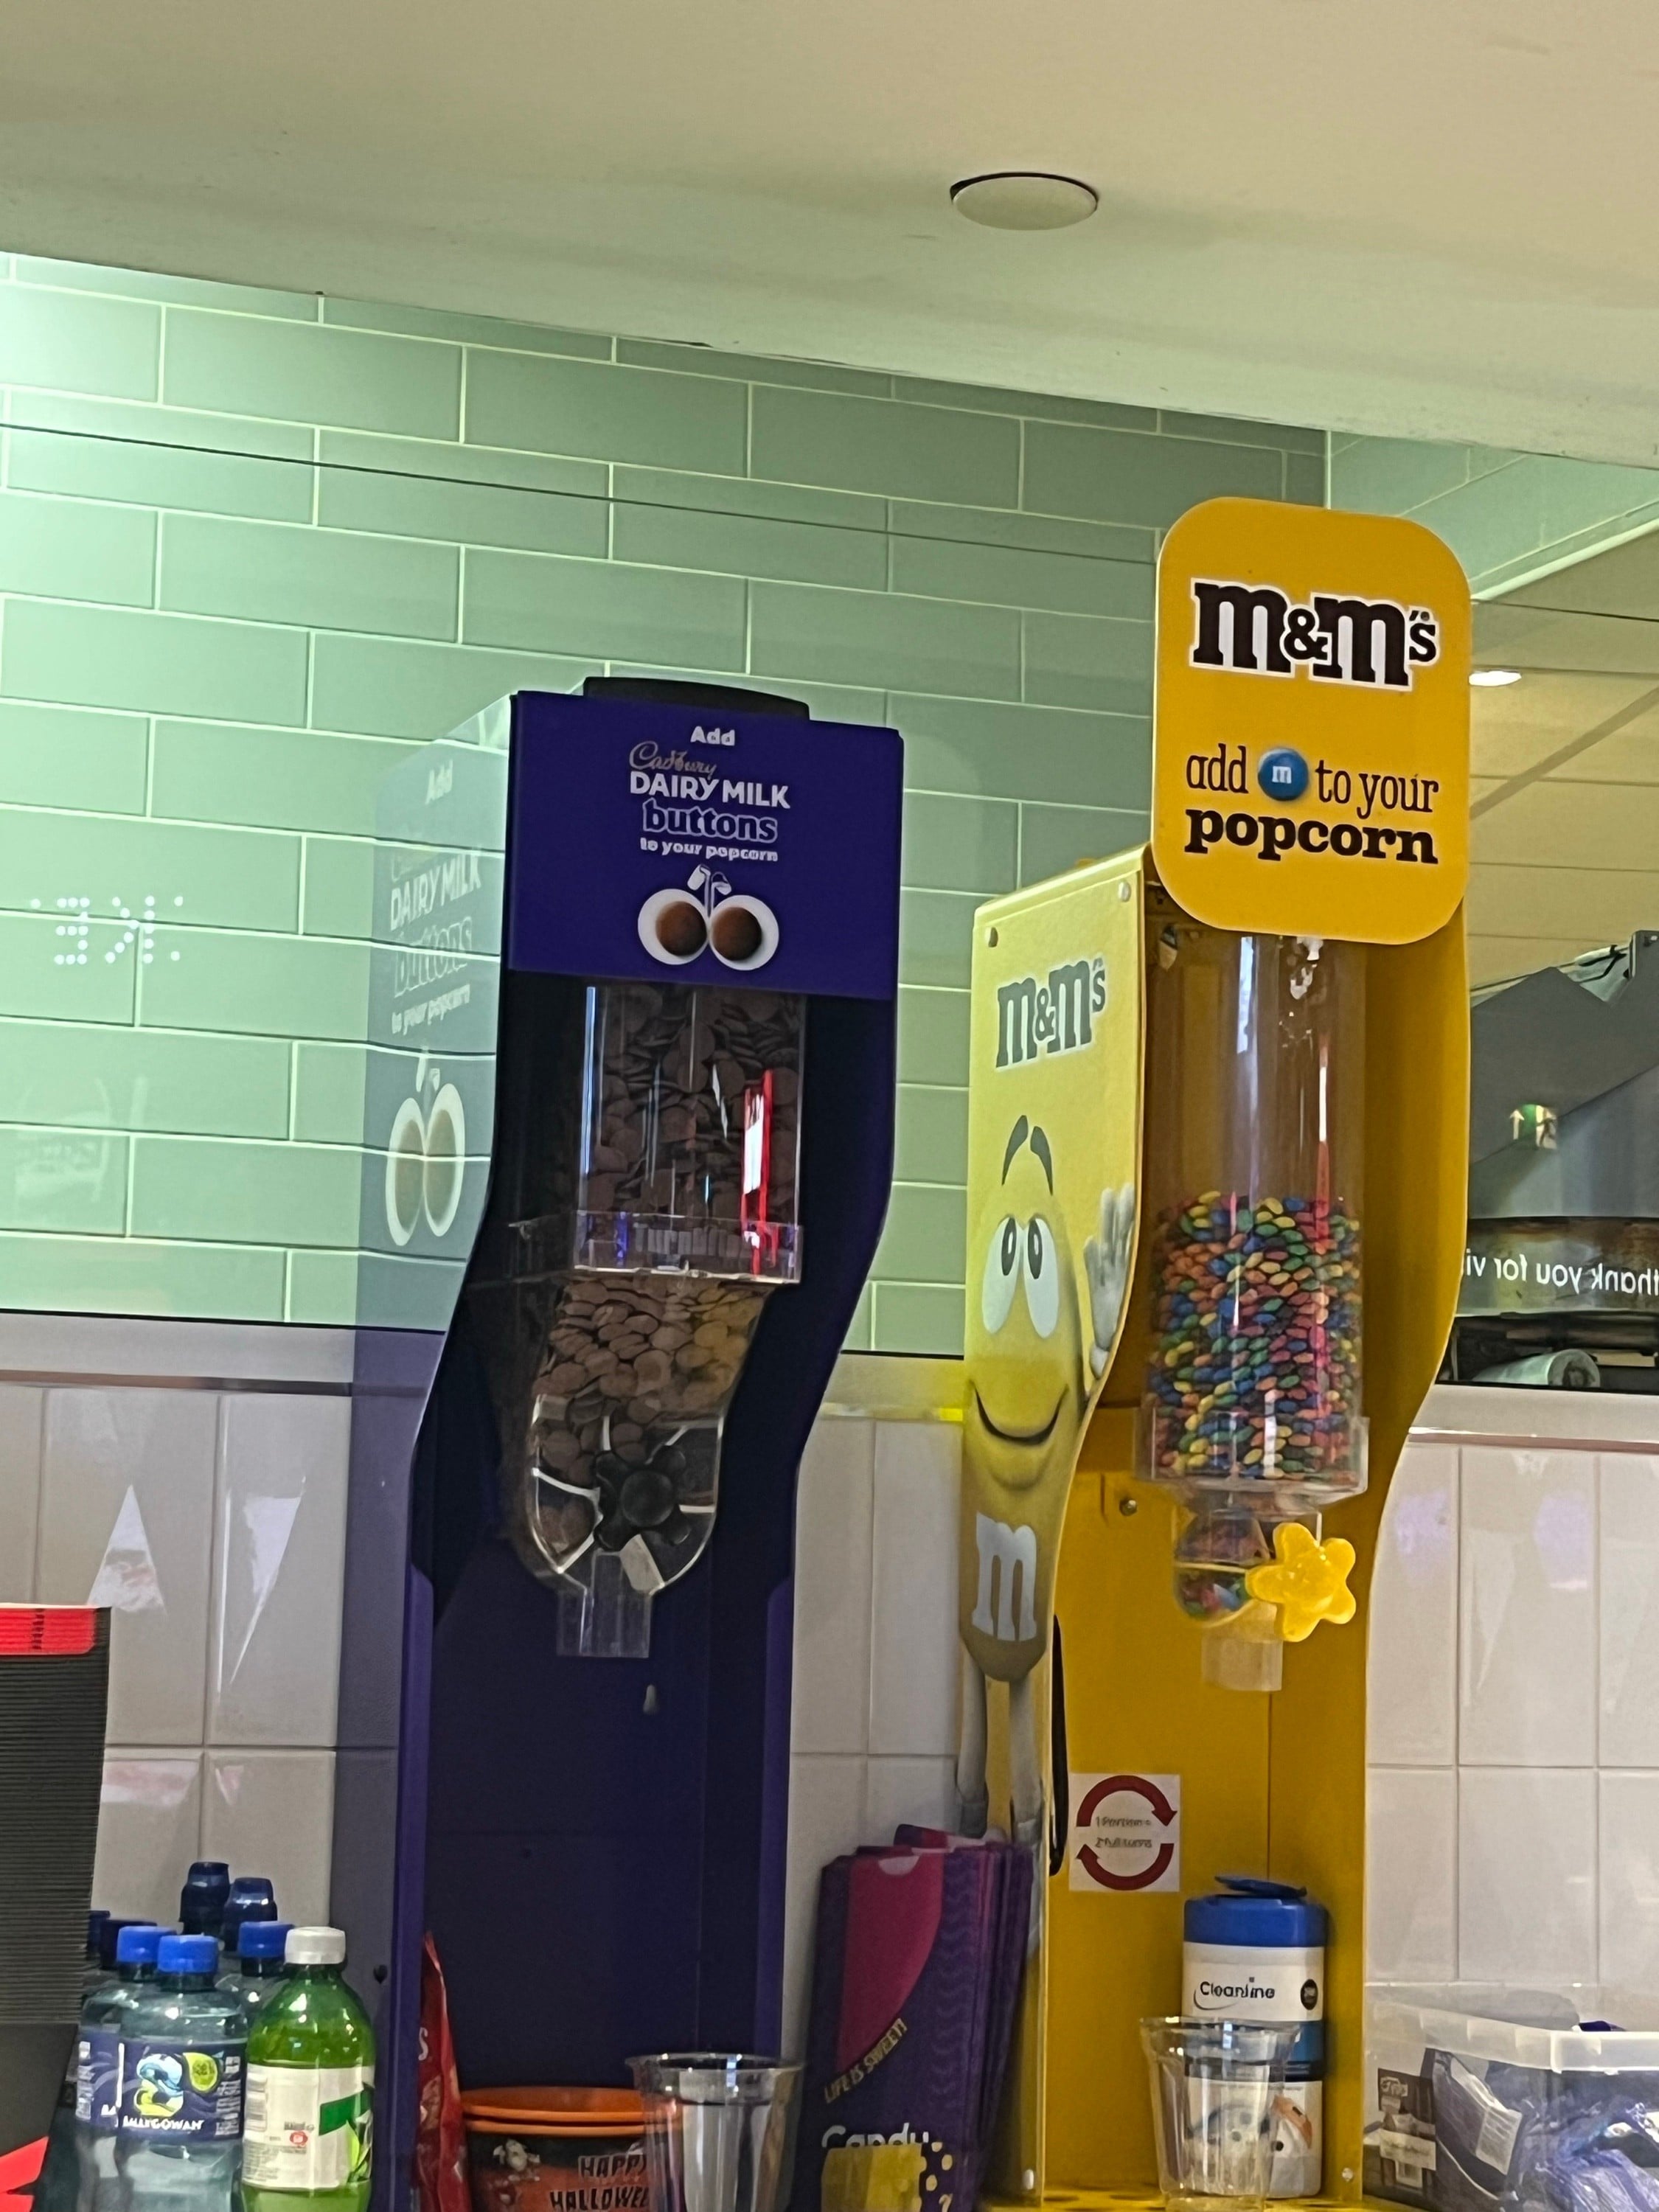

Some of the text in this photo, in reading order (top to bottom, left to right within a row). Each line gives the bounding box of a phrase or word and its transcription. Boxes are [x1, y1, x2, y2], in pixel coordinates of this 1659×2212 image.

[690, 726, 735, 746] Add
[629, 740, 717, 779] Cadbury
[630, 771, 791, 809] DAIRY MILK
[1186, 742, 1248, 794] add
[1315, 759, 1352, 804] to
[1357, 772, 1439, 820] your
[642, 797, 778, 844] buttons
[1184, 809, 1439, 864] popcorn
[640, 838, 779, 861] to your popcorn
